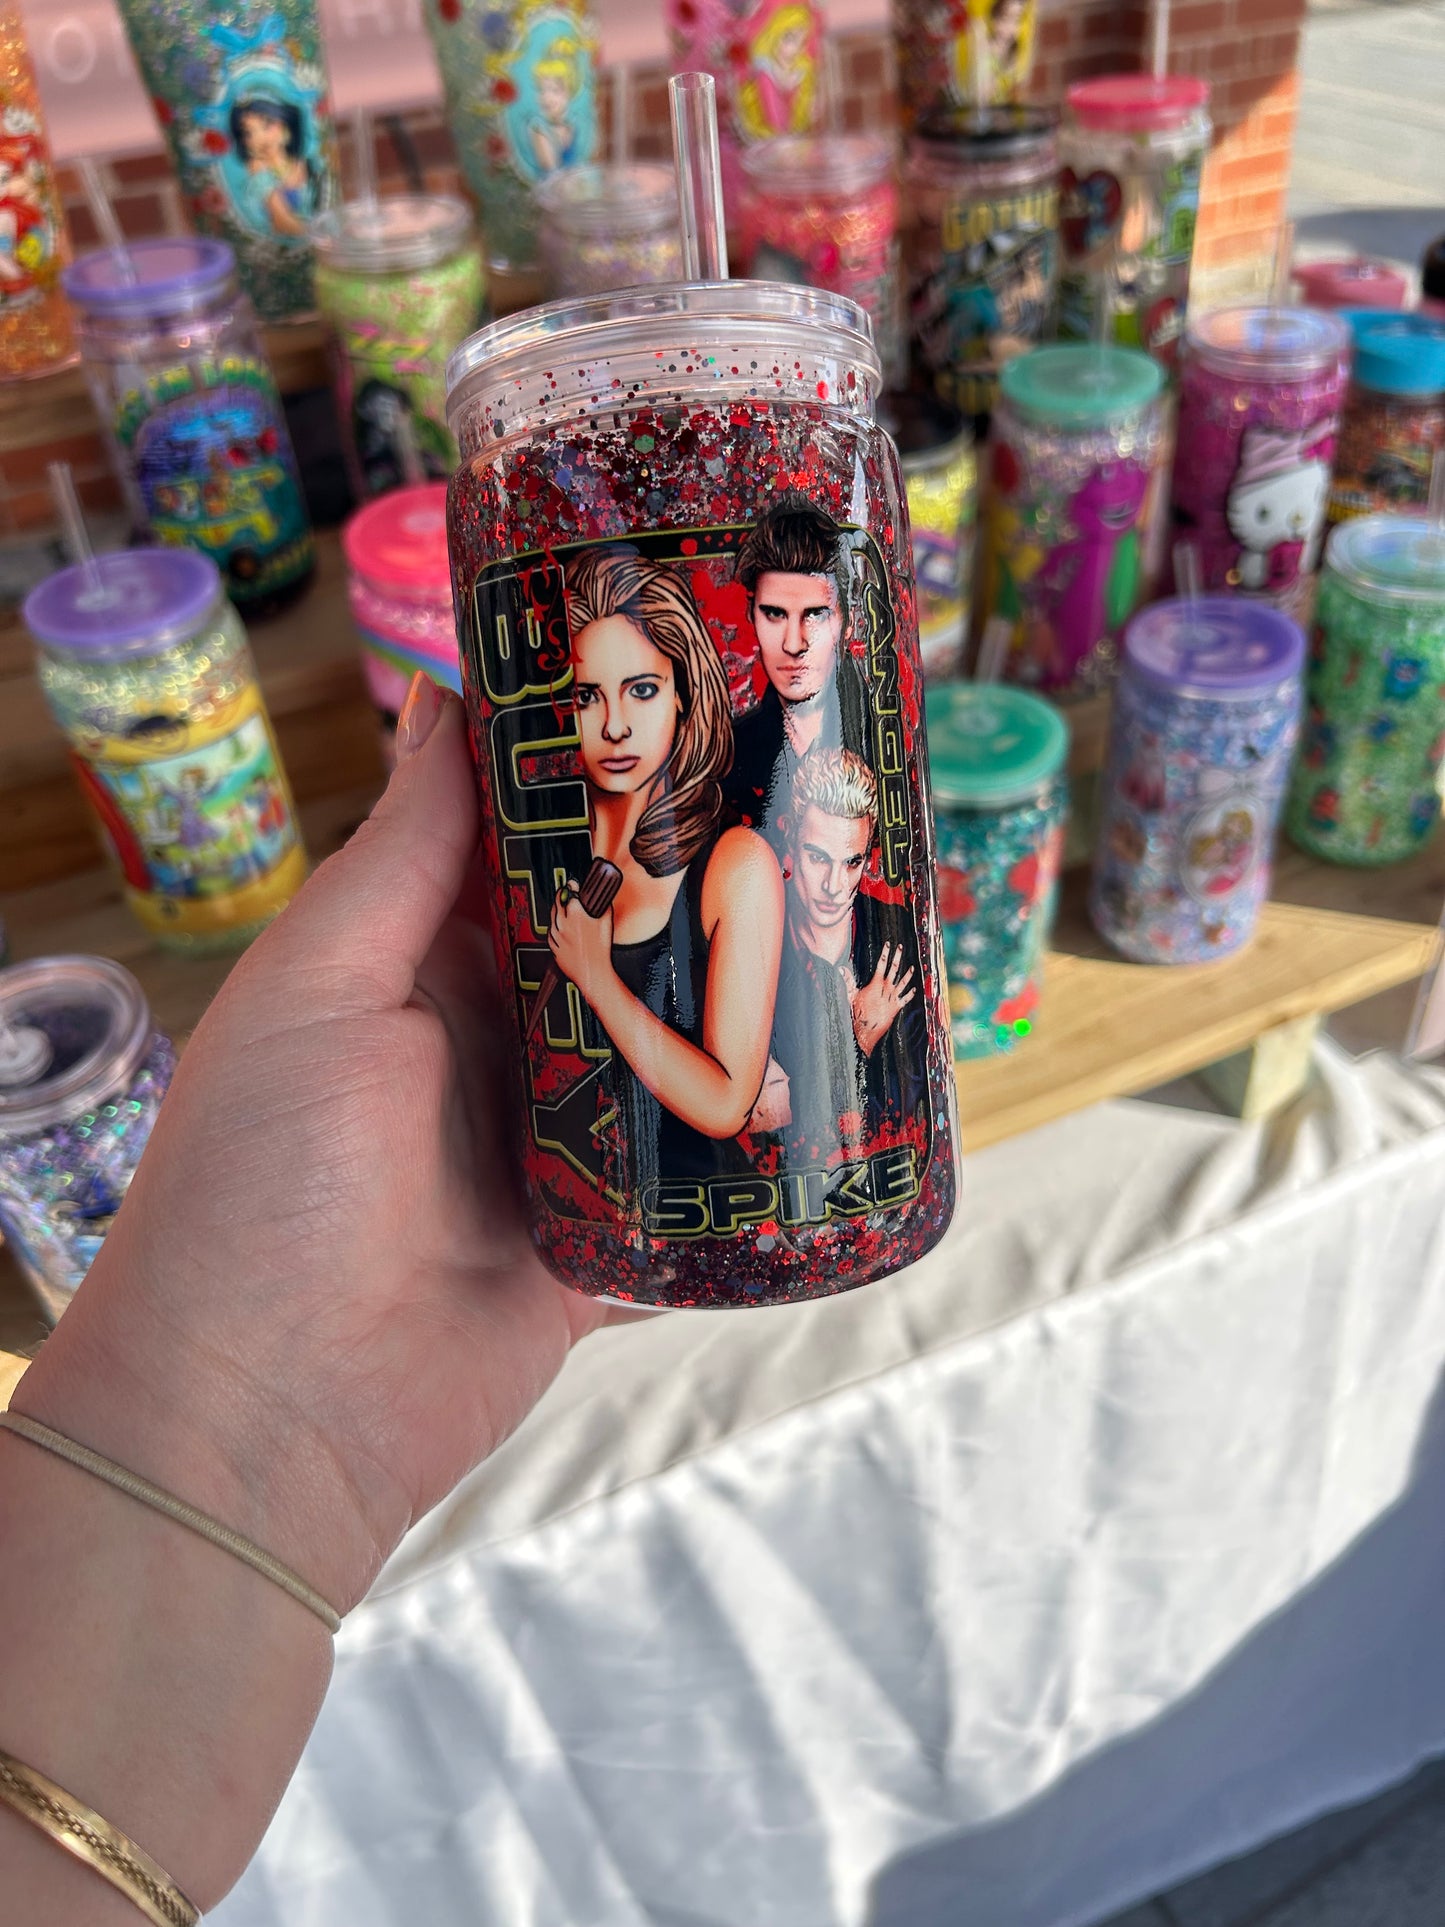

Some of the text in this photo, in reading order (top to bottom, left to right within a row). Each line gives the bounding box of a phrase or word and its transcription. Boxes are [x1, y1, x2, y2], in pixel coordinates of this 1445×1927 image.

[866, 582, 908, 881] ANGEL
[474, 563, 626, 1206] BUFFY
[641, 1148, 918, 1232] SPIKE
